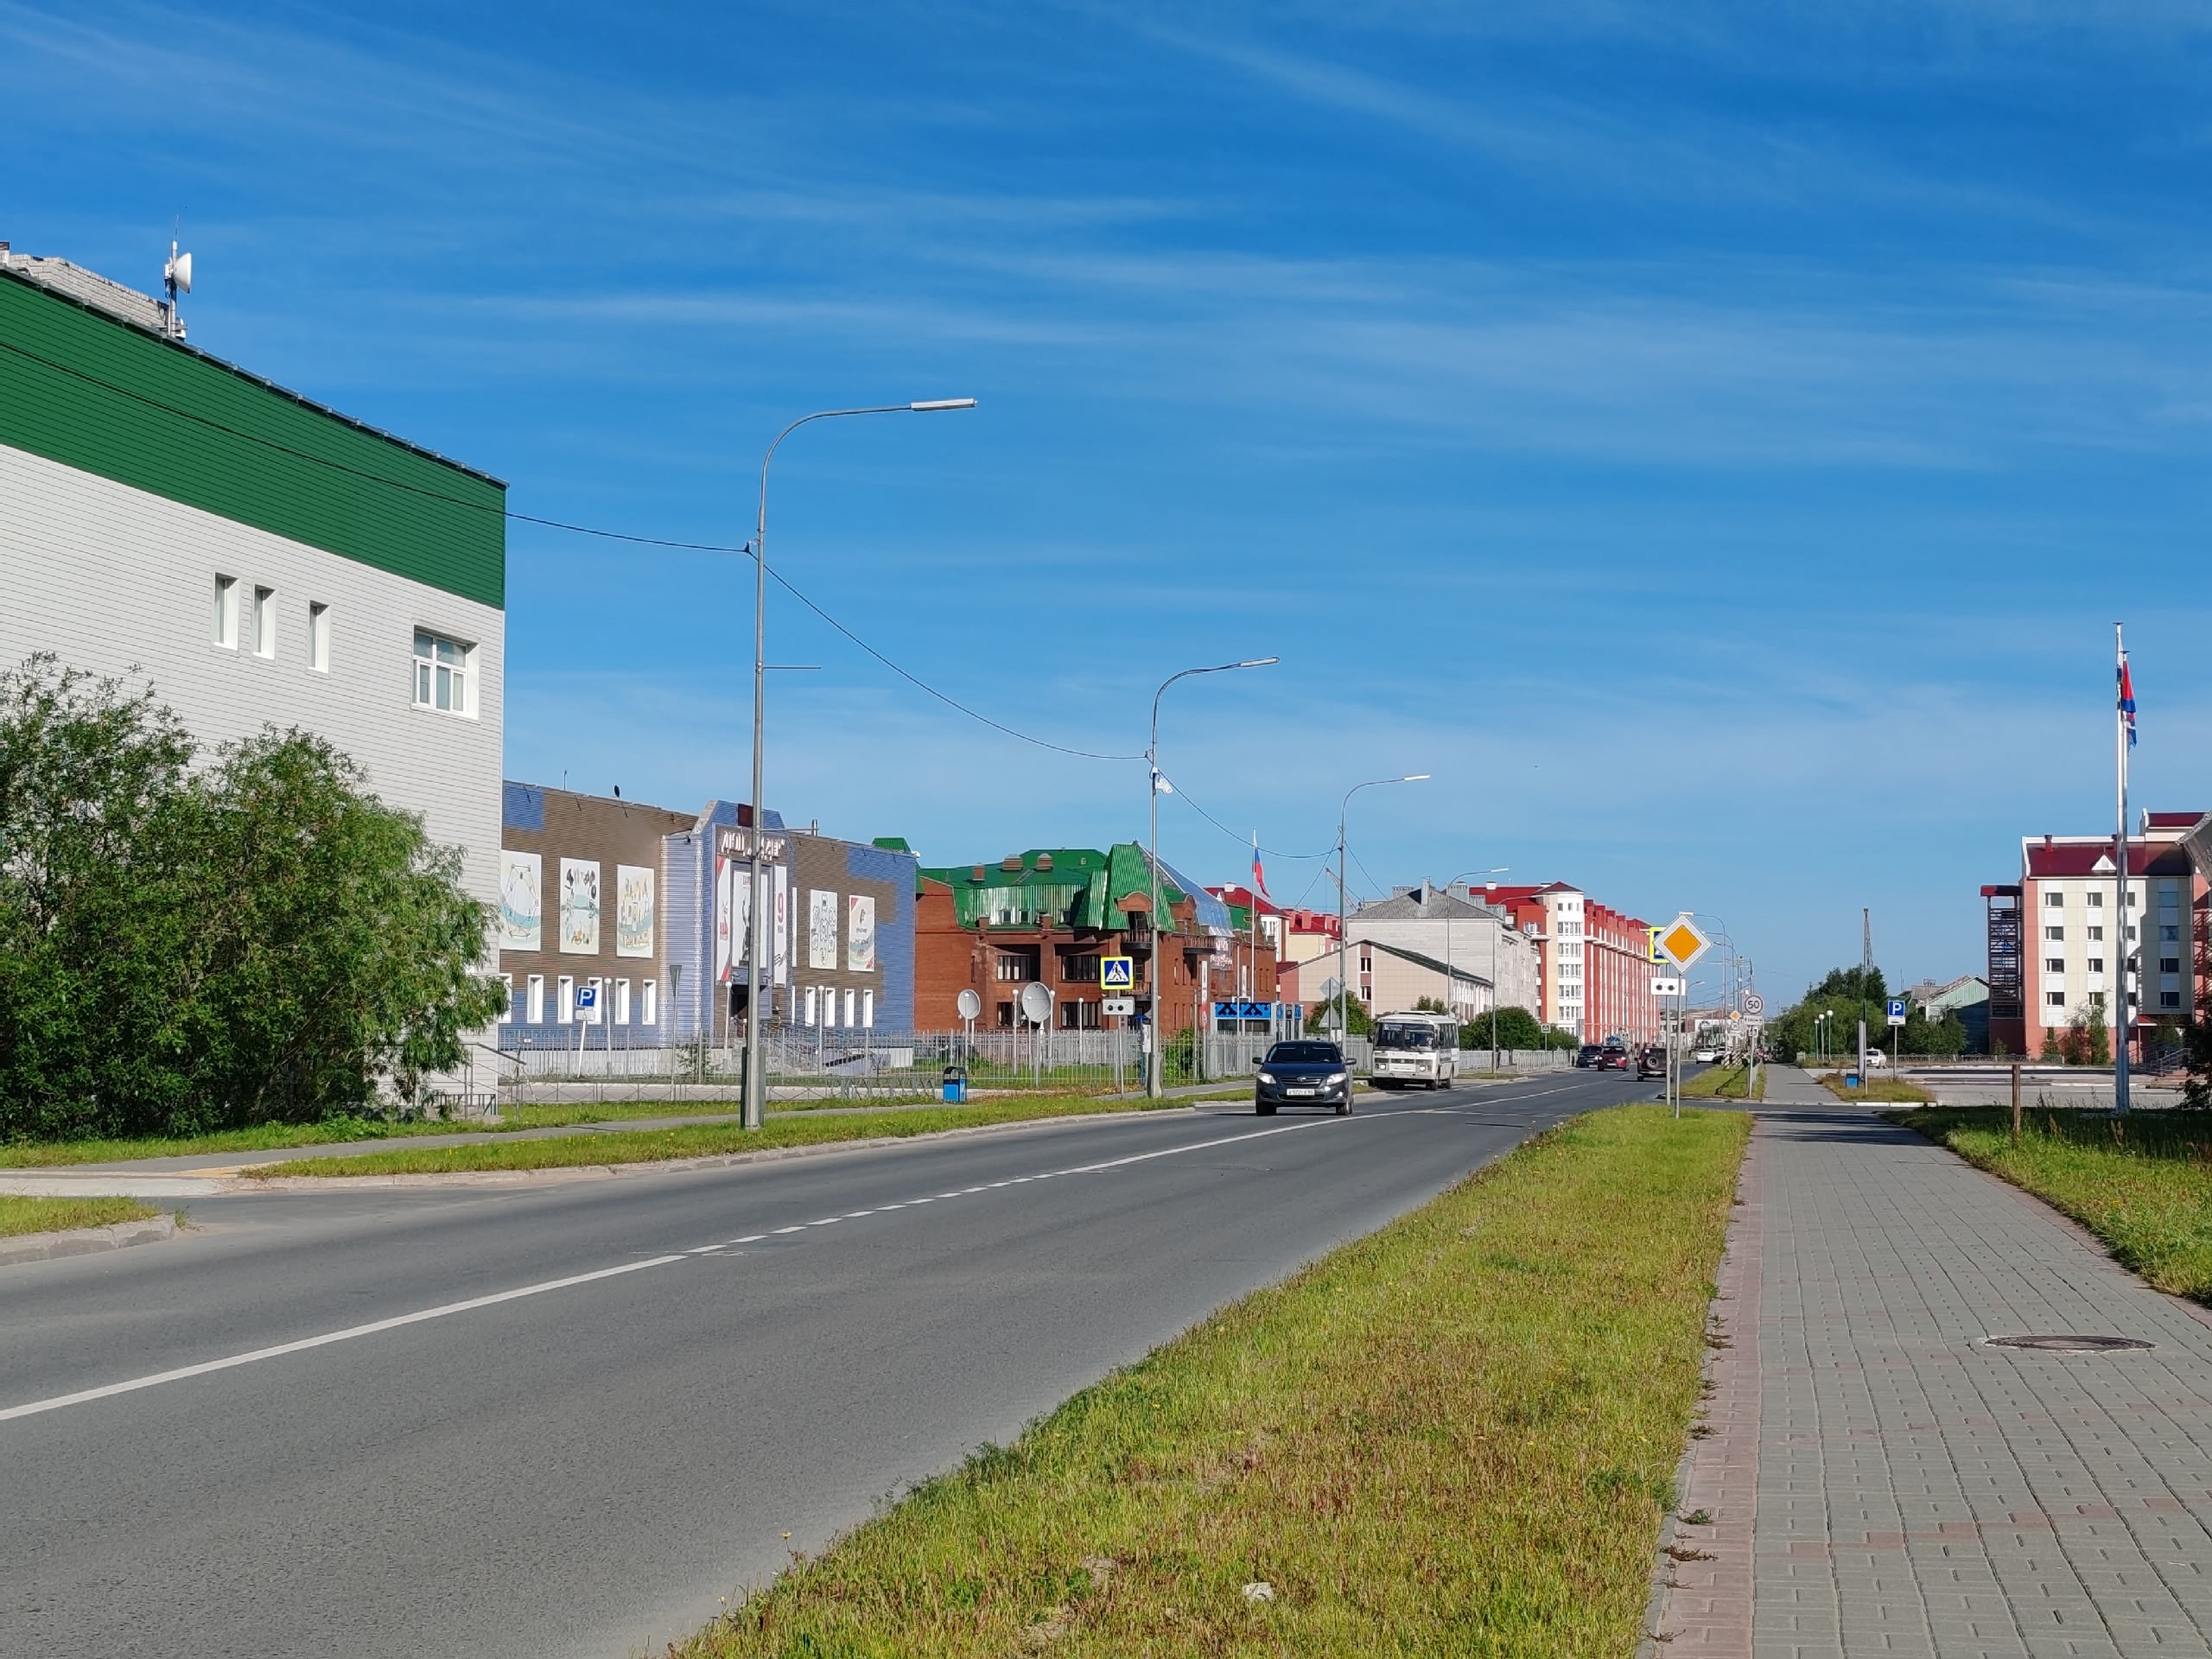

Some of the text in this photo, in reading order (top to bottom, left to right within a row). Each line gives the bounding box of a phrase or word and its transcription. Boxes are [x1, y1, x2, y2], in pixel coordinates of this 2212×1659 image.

[580, 988, 593, 1005] P
[1747, 1000, 1760, 1009] 50
[1892, 1001, 1902, 1015] P
